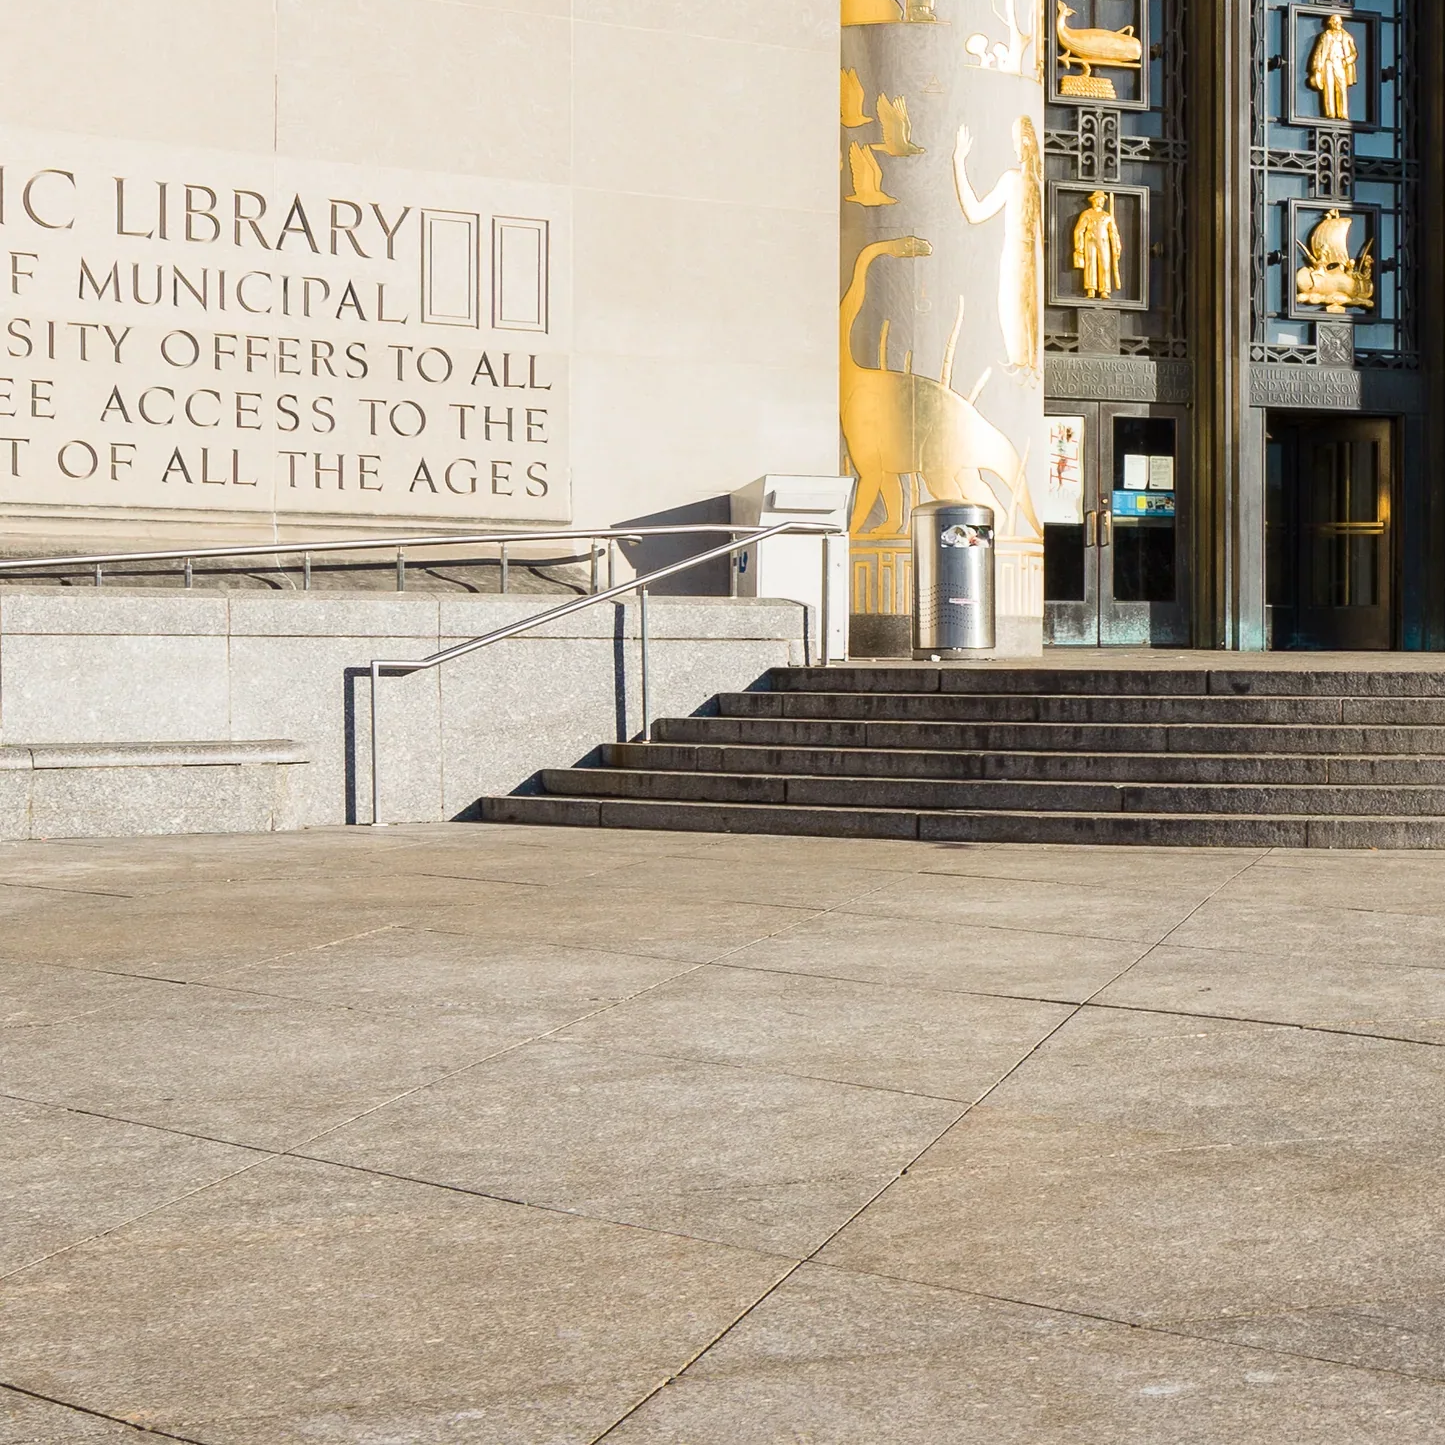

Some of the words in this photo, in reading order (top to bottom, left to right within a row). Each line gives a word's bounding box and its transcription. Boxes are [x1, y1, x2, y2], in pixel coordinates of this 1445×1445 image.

[112, 177, 412, 260] LIBRARY
[9, 251, 39, 295] F
[78, 256, 408, 324] MUNICIPAL
[7, 318, 133, 364] SITY
[161, 330, 368, 379] OFFERS
[388, 345, 453, 383] TO
[471, 351, 552, 390] ALL
[1052, 370, 1099, 382] WINGS
[1096, 361, 1137, 372] ARROW
[100, 385, 335, 433] ACCESS
[359, 399, 426, 437] TO
[449, 404, 548, 443] THE
[1051, 383, 1077, 394] AND
[1250, 380, 1277, 391] AND
[1325, 383, 1358, 394] KNOW
[0, 438, 30, 477] T
[58, 440, 136, 481] OF
[162, 446, 257, 487] ALL
[278, 451, 383, 492] THE
[409, 457, 548, 497] AGES
